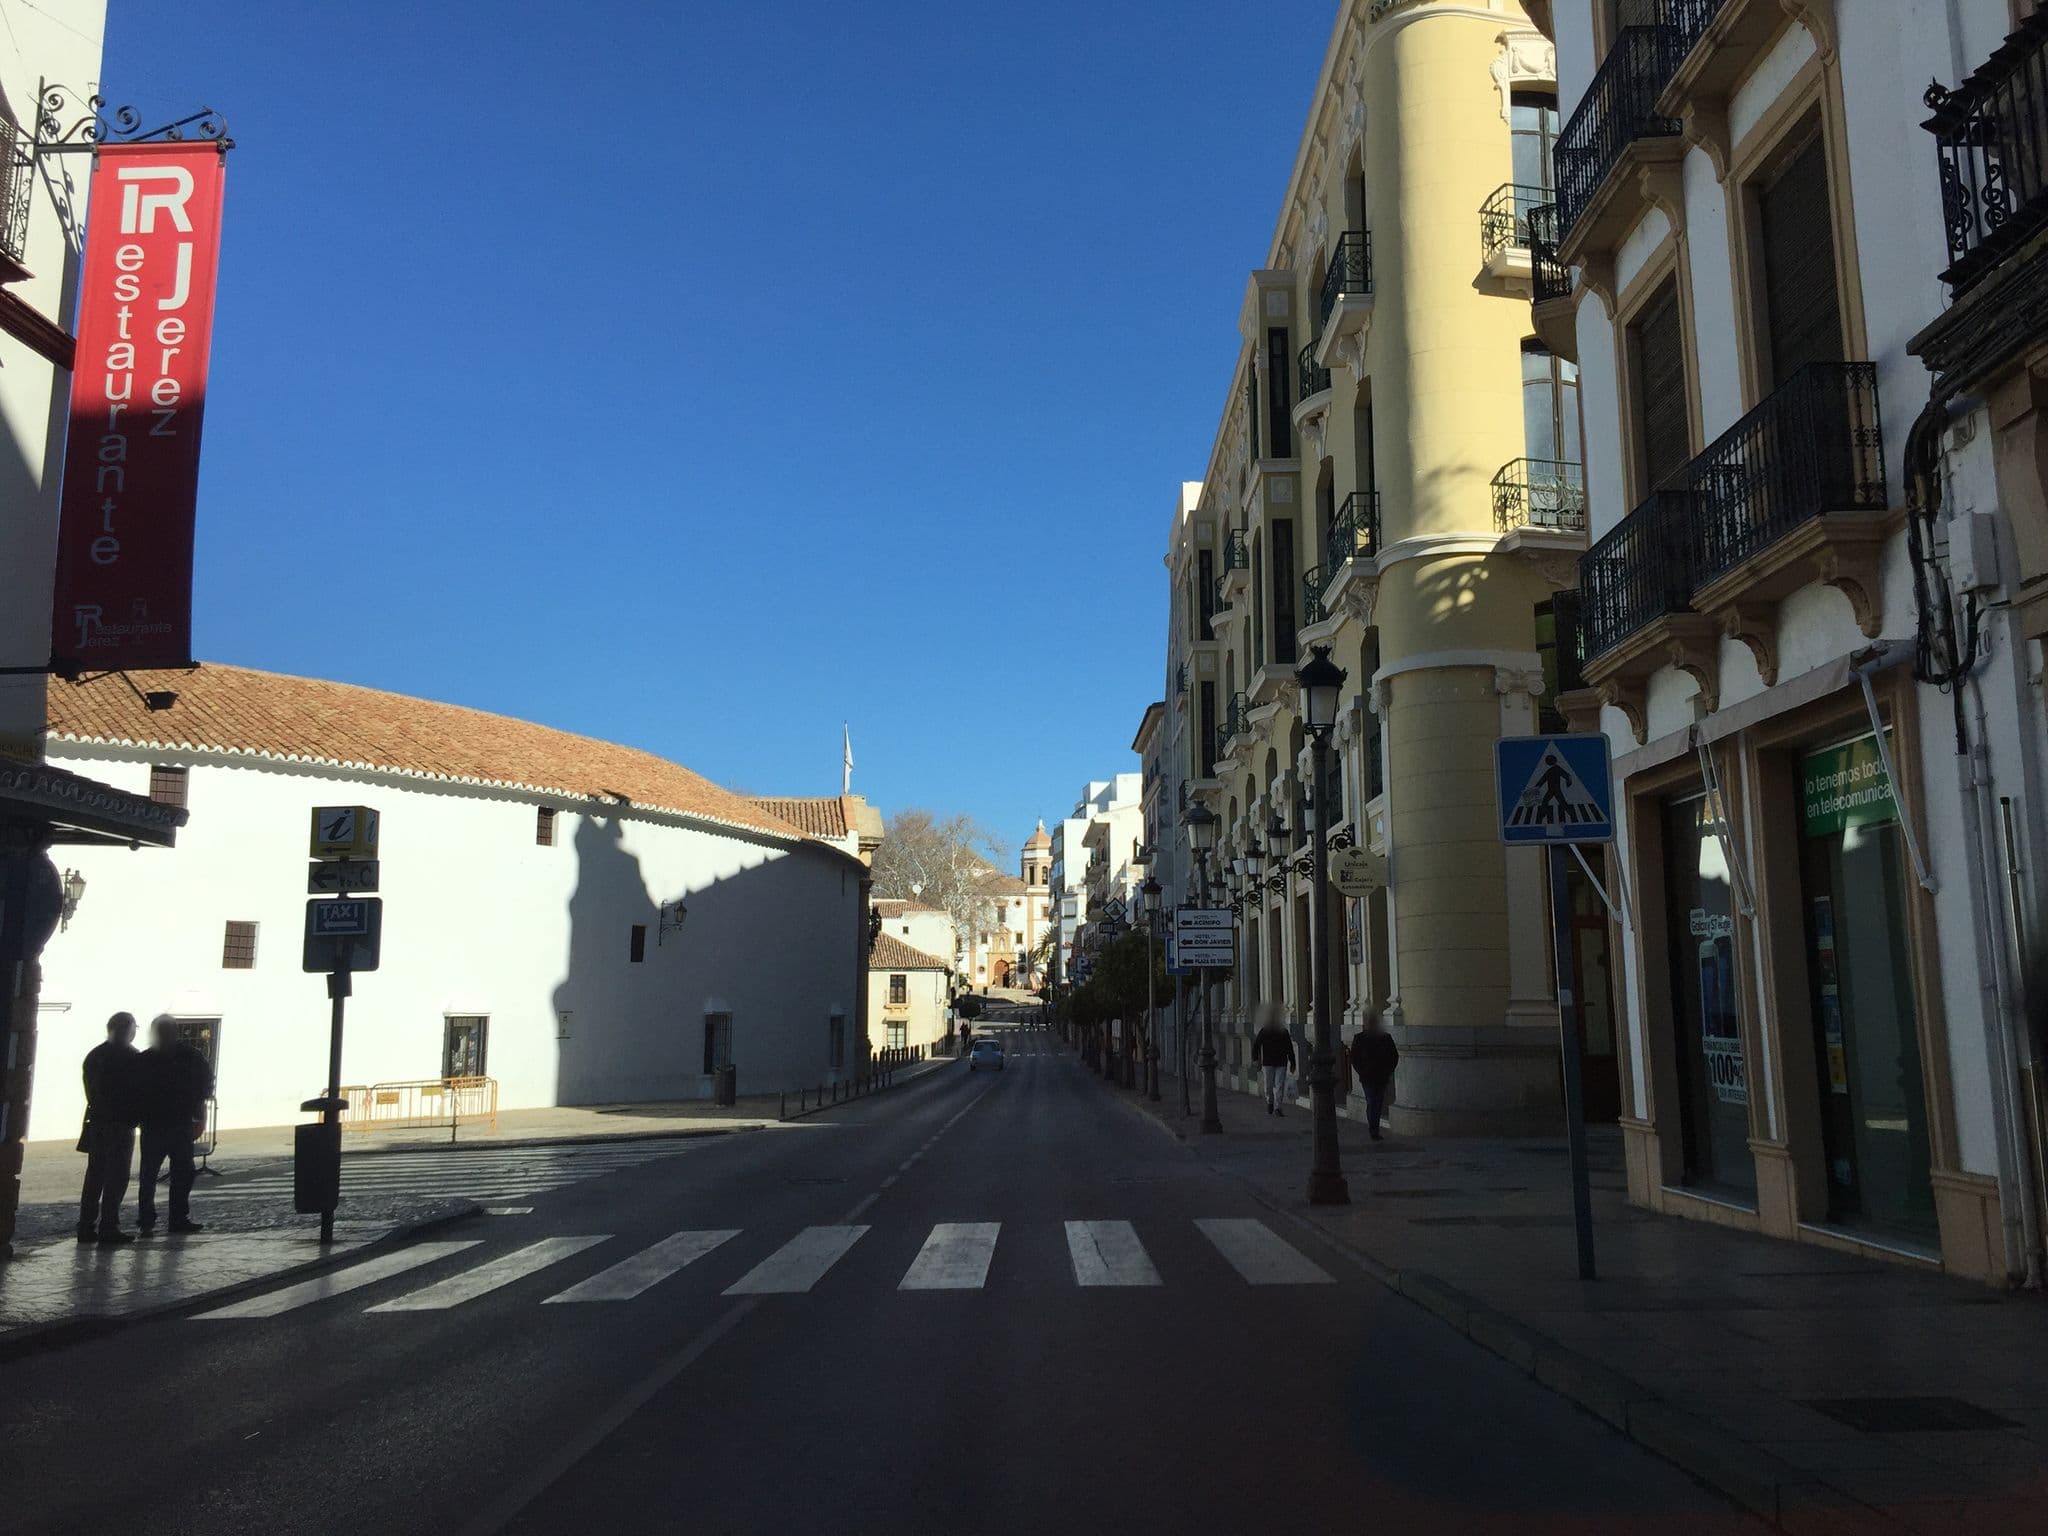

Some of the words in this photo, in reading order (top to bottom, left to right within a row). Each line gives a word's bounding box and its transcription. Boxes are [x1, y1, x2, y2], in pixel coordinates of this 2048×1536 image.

[148, 242, 195, 437] Jerez
[1803, 778, 1815, 796] lo
[1815, 765, 1861, 793] tenemos
[1806, 803, 1820, 818] en
[319, 903, 359, 920] TAXI
